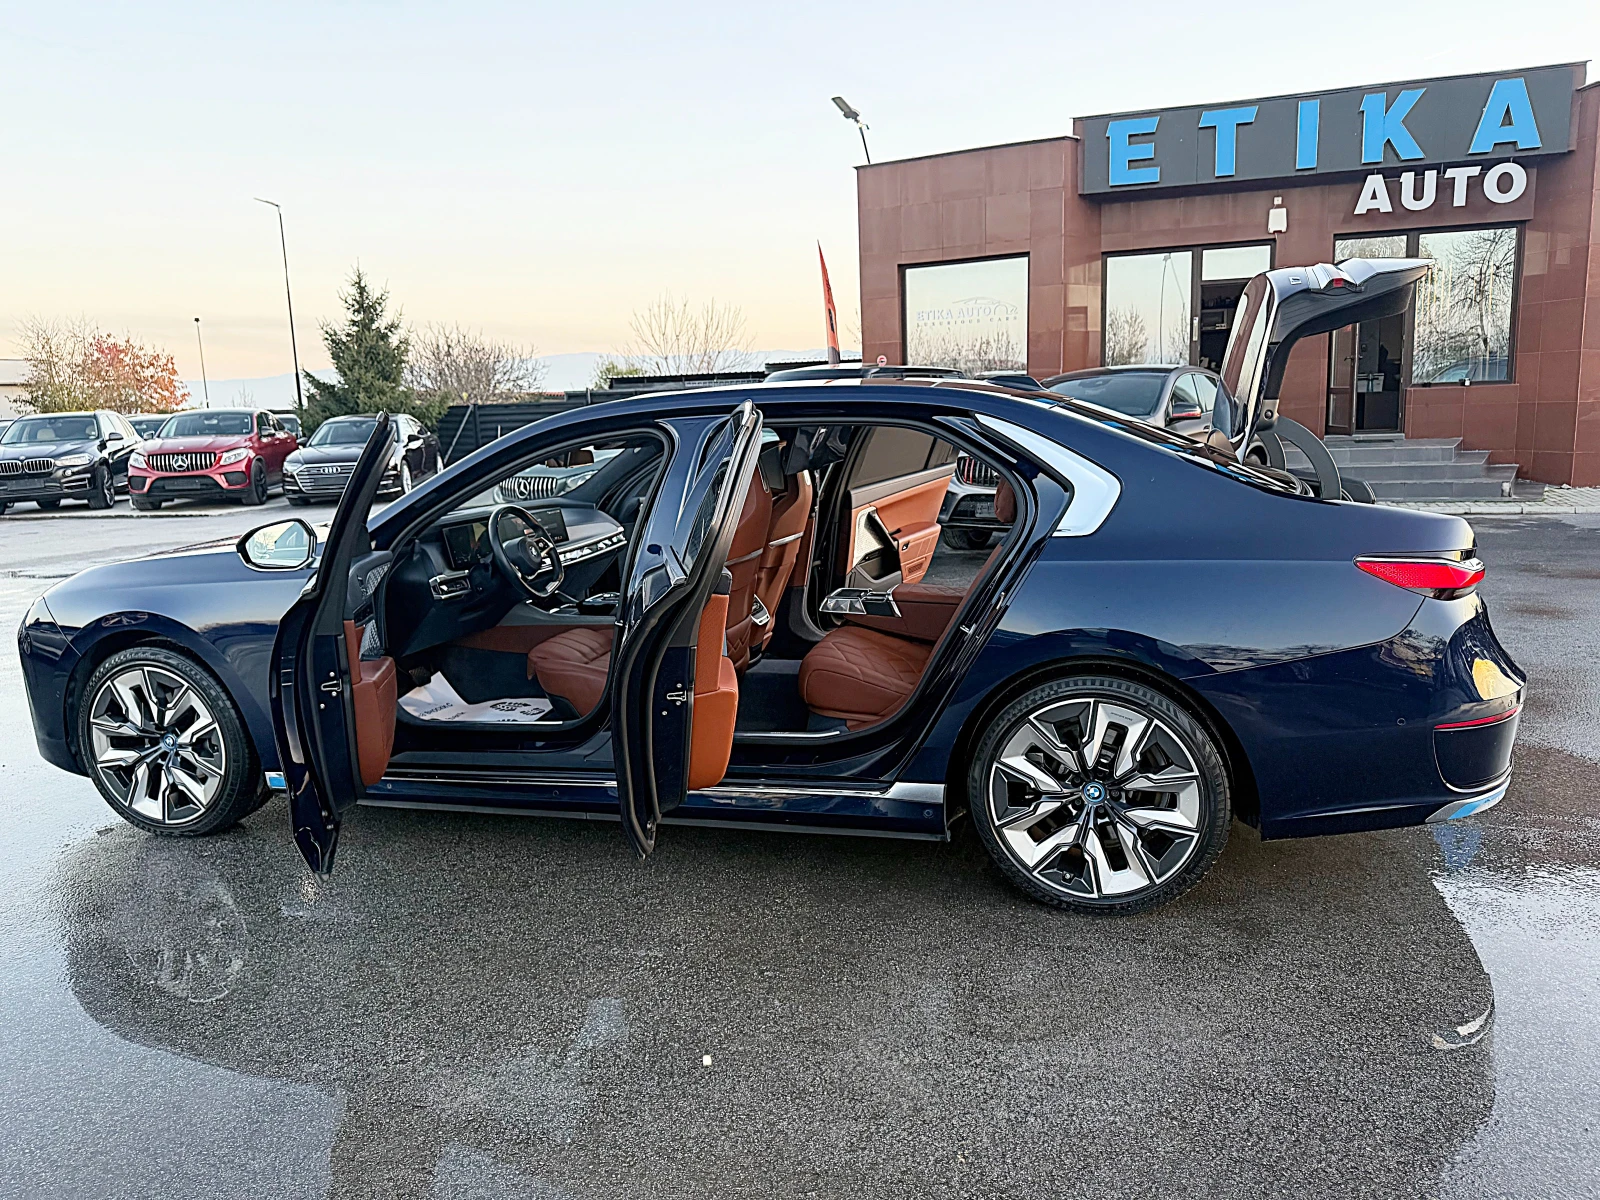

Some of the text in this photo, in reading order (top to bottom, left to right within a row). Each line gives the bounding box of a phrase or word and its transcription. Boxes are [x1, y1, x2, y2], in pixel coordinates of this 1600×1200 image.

[1105, 77, 1542, 187] ETIKA
[1354, 162, 1528, 215] AUTO
[916, 306, 991, 321] ETIKA AUTO
